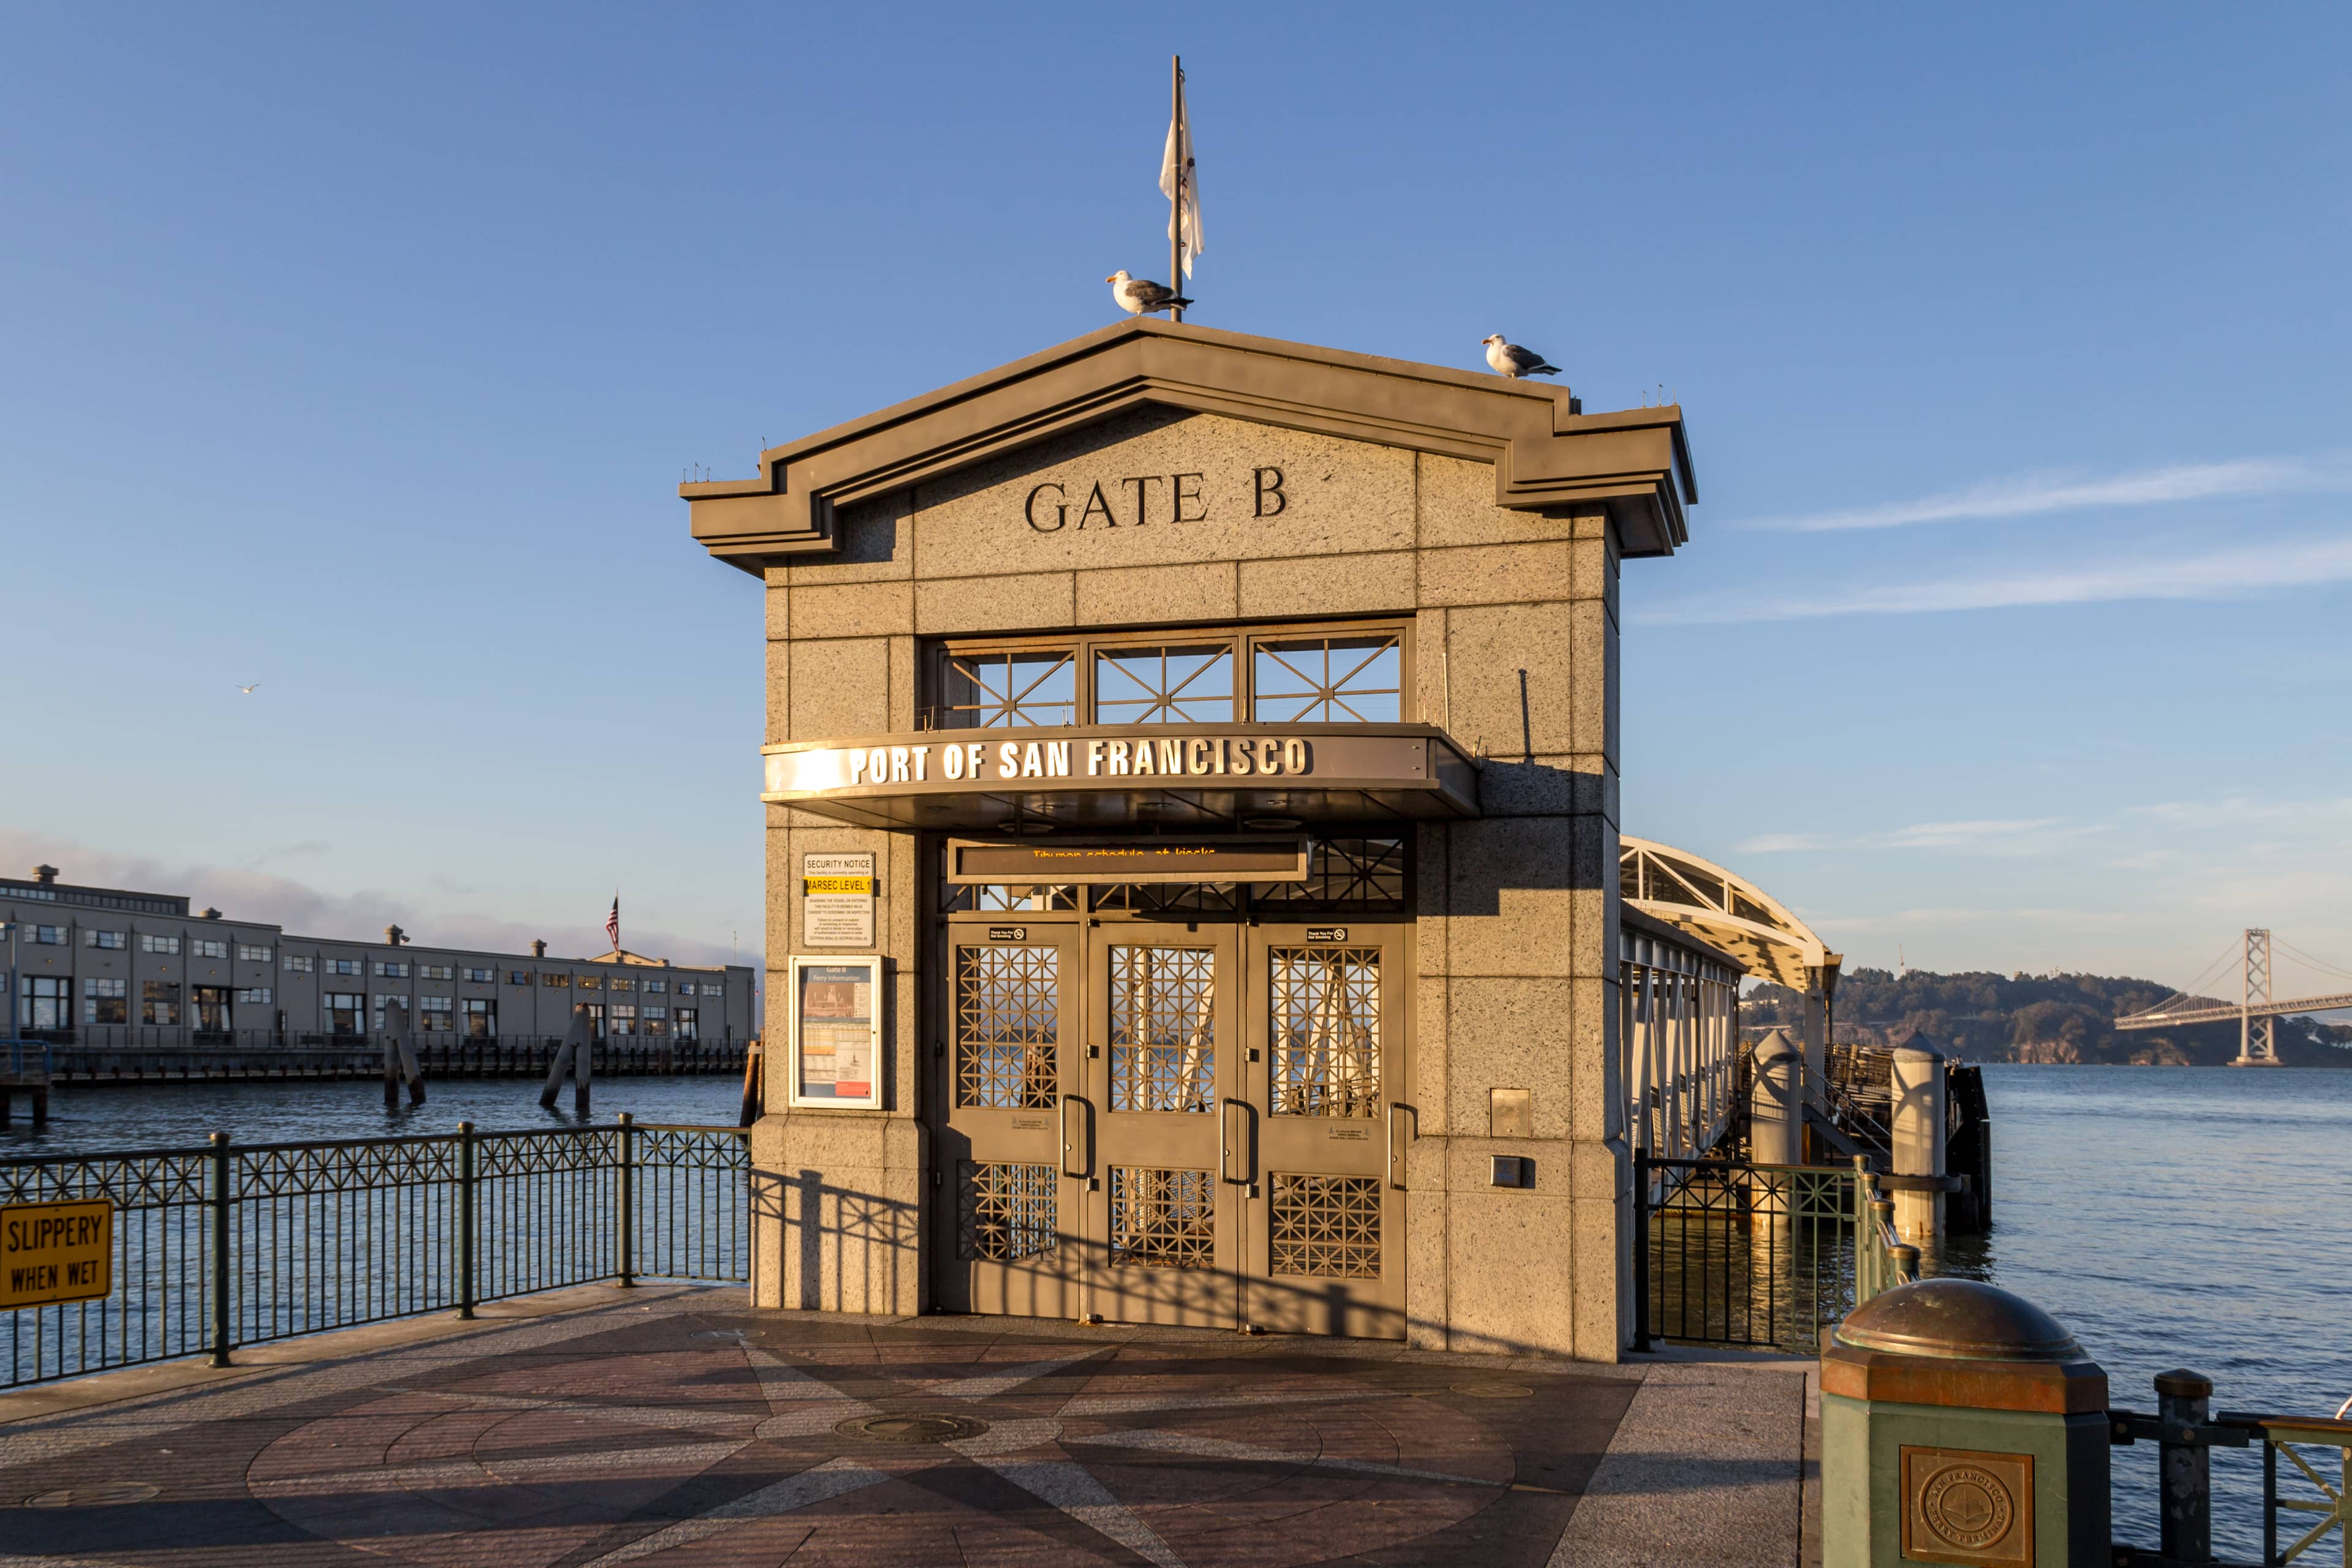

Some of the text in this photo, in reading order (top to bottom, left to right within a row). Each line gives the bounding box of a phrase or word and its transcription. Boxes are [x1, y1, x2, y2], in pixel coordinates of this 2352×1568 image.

[1025, 467, 1287, 533] GATE B
[850, 738, 1313, 785] PORT OF SAN FRANCISCO
[807, 880, 870, 890] MARSEC LEVEL 1
[8, 1215, 102, 1252] SLIPPERY
[11, 1260, 99, 1292] WHEN WET
[1929, 1471, 2003, 1502] SAN FRANCISCO
[1930, 1510, 2005, 1543] FERRY TERMINAL
